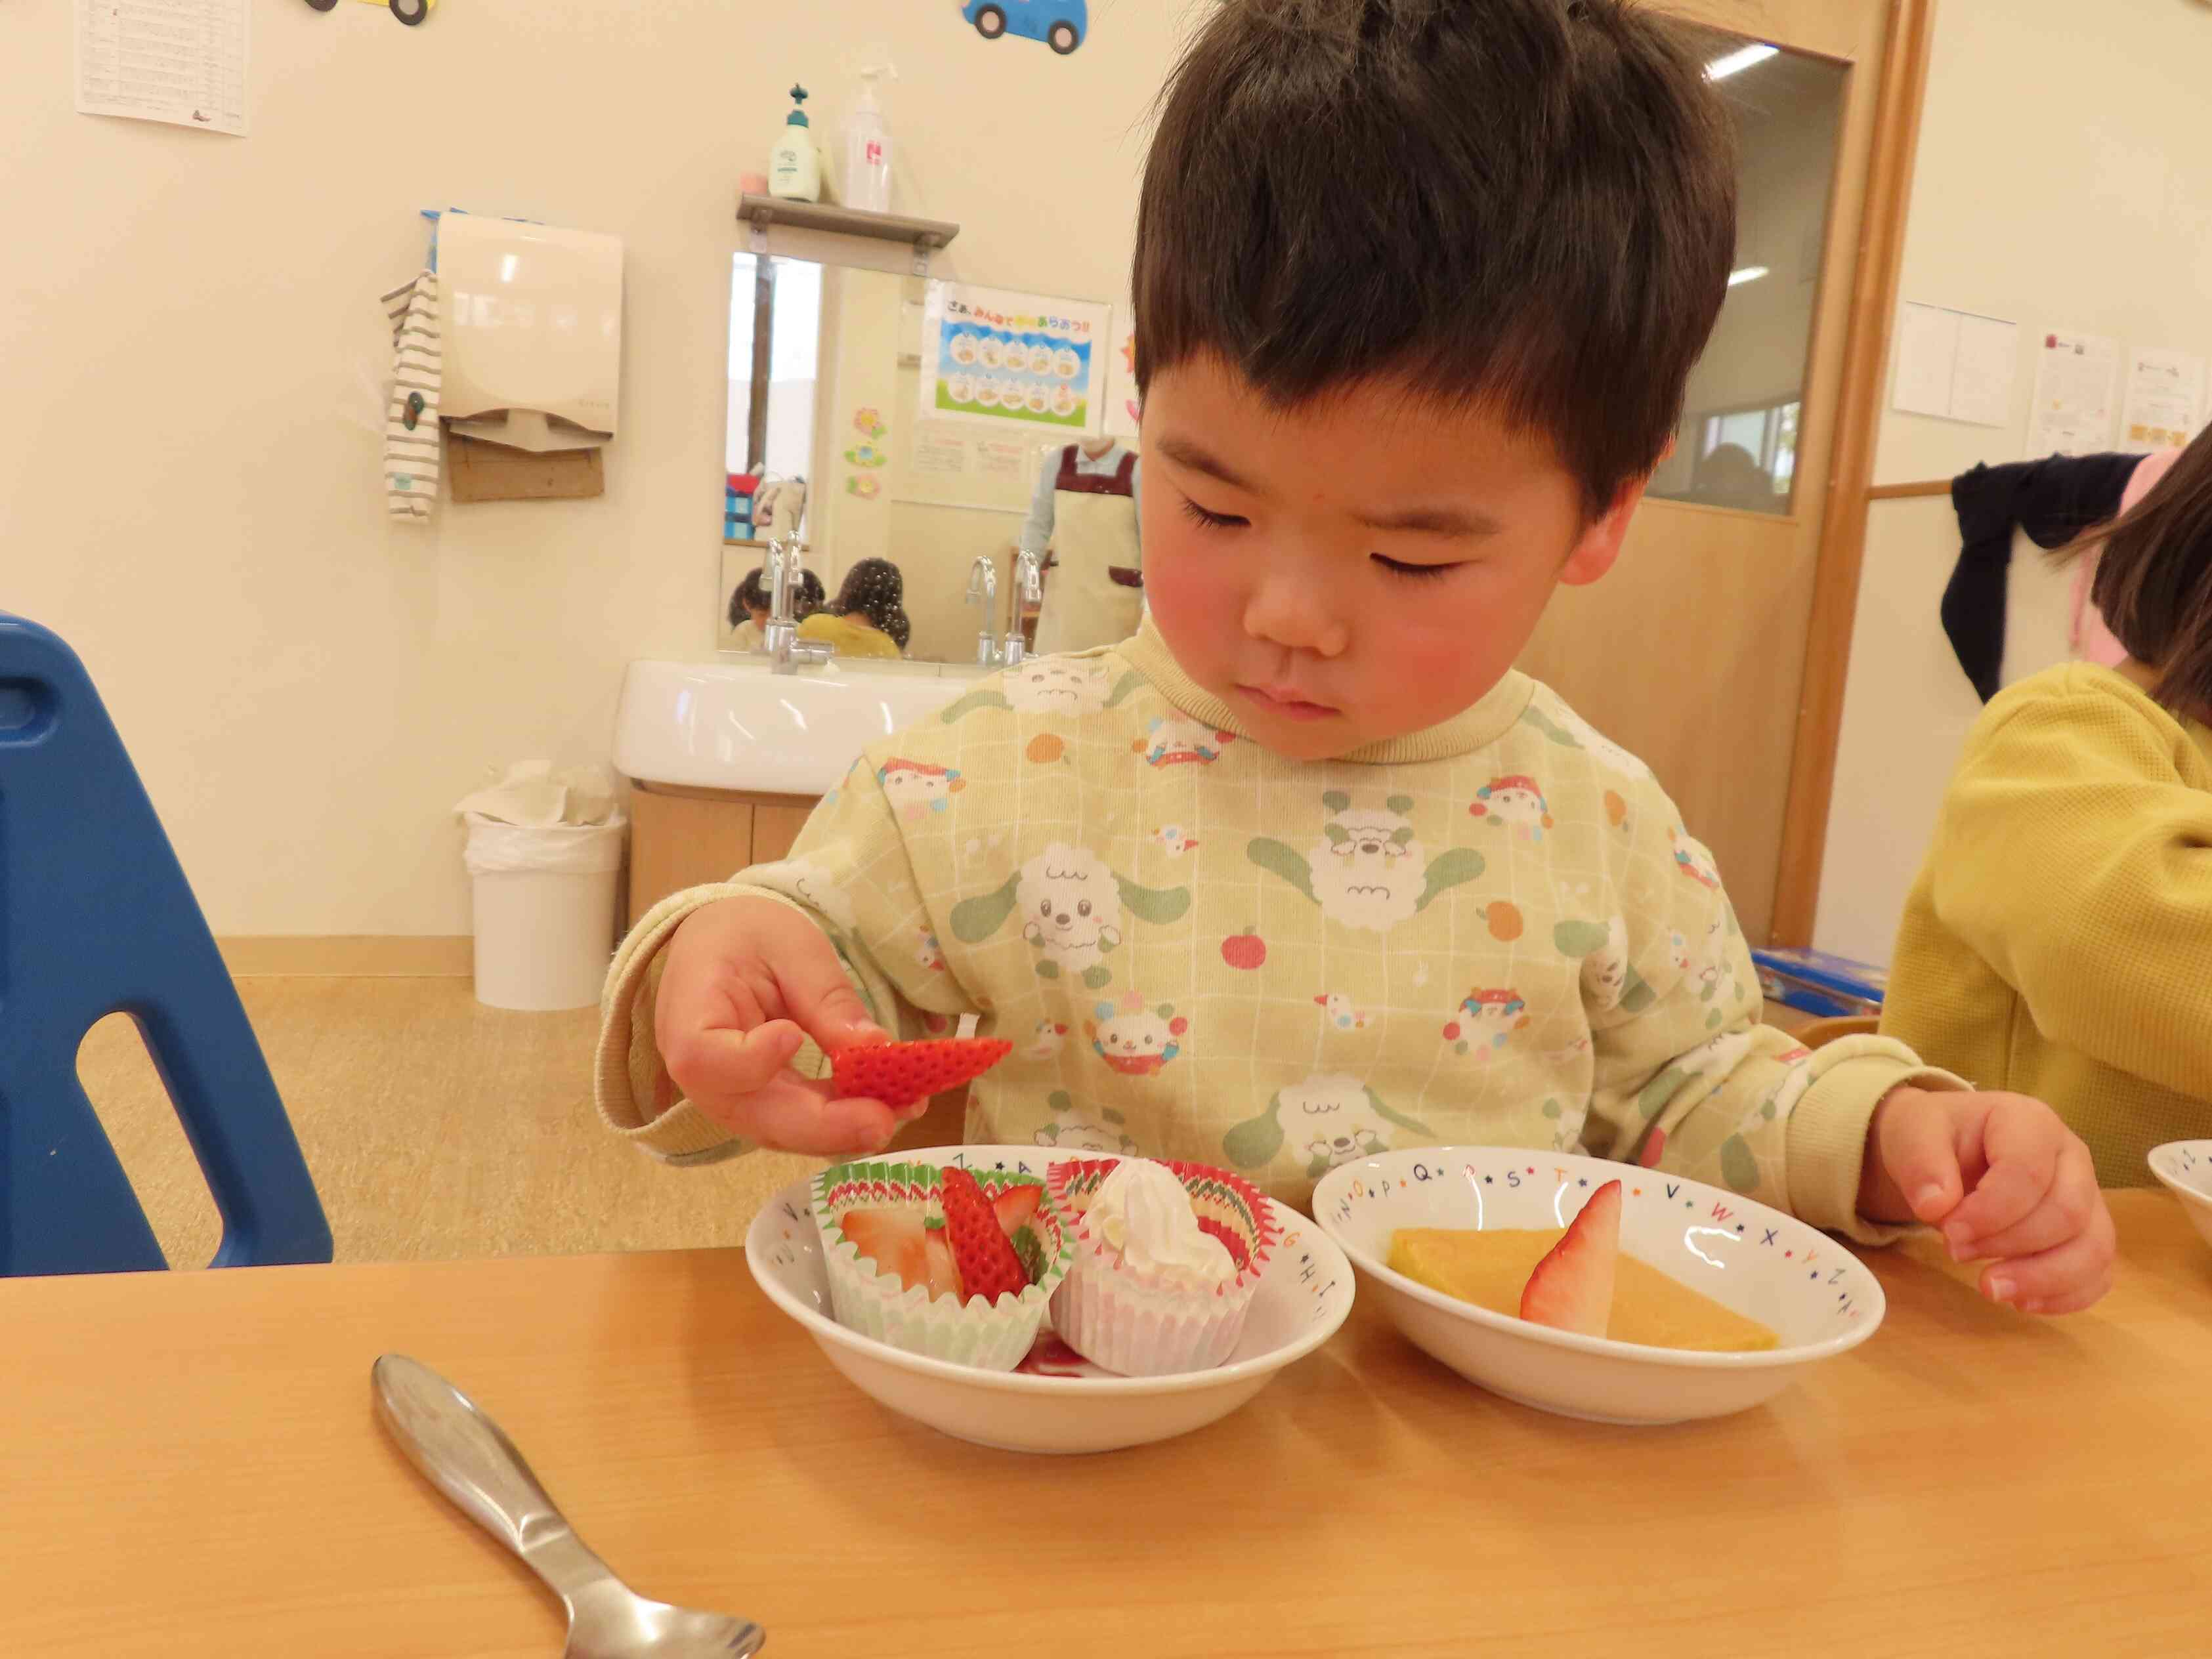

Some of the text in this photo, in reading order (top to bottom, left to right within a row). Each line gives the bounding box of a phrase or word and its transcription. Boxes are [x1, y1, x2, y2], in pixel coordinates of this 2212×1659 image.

[1283, 1232, 1302, 1248] G
[1300, 1264, 1315, 1284] H
[1353, 1179, 1363, 1198] O
[1382, 1179, 1390, 1198] P
[1413, 1164, 1432, 1181] Q
[1507, 1171, 1521, 1188] S
[1554, 1166, 1567, 1183] T
[1666, 1183, 1680, 1199] V
[1711, 1202, 1733, 1222] W
[1760, 1228, 1779, 1246] X
[1827, 1268, 1846, 1285] Z
